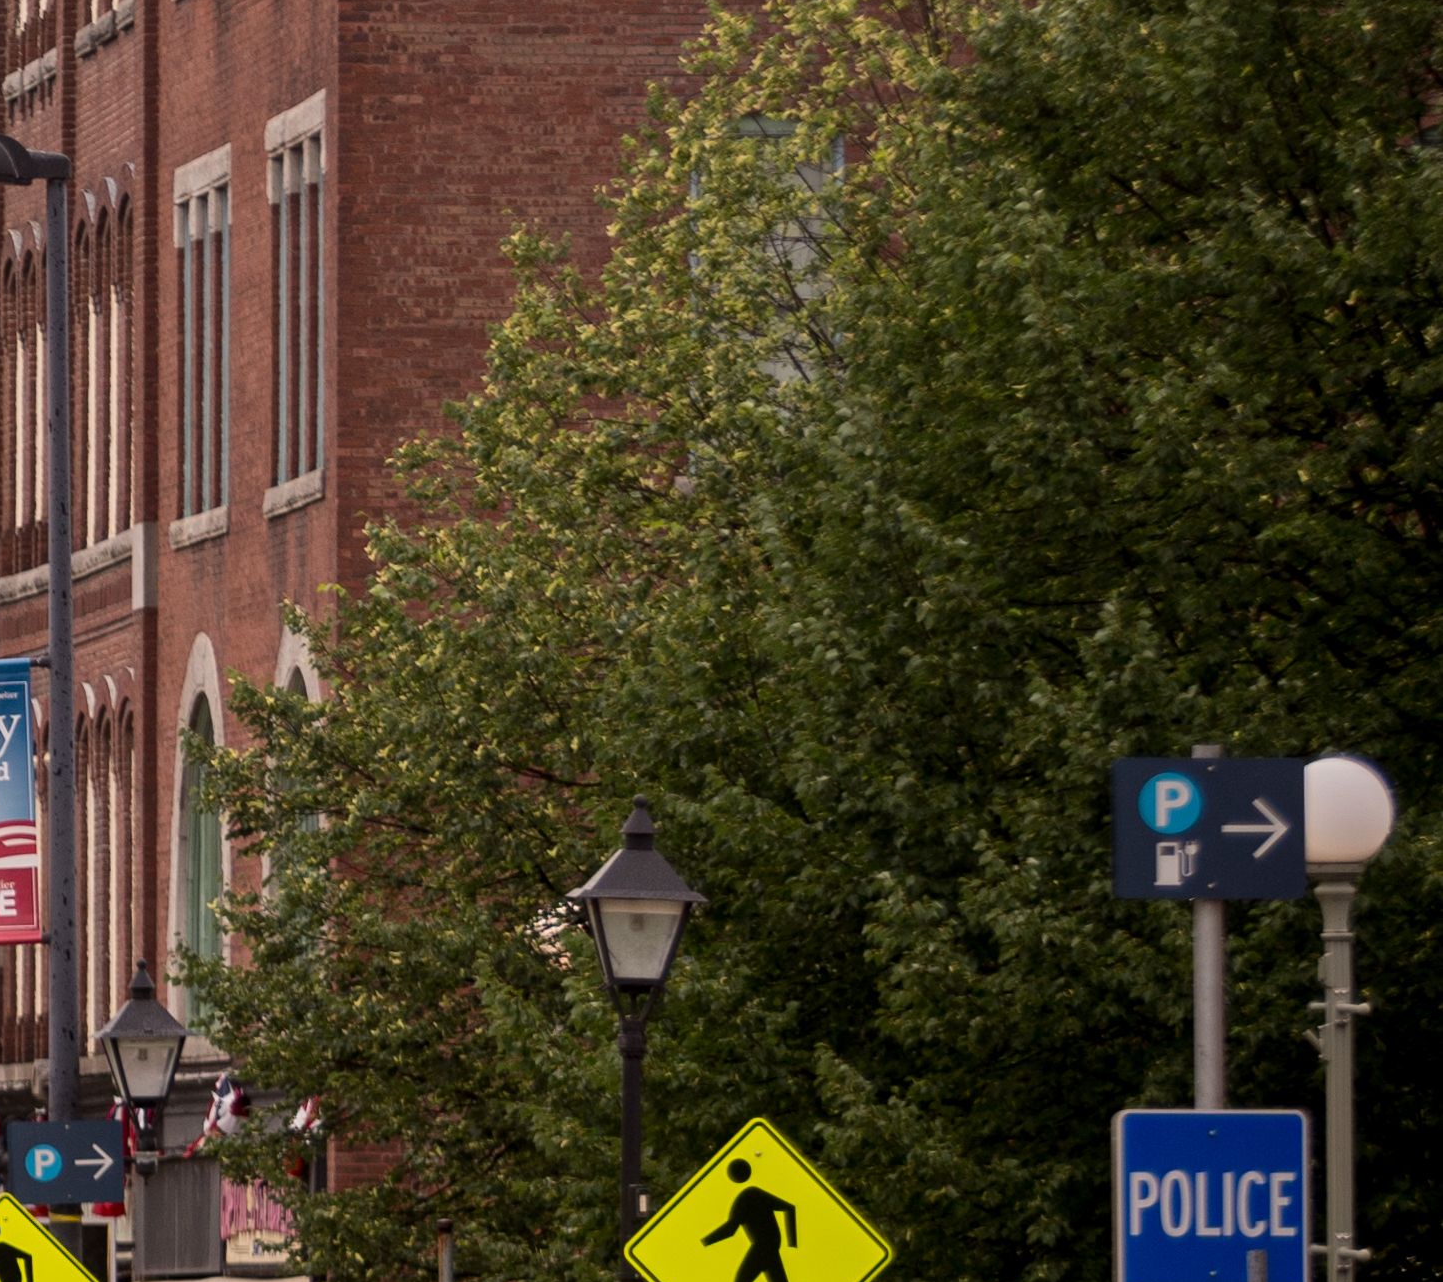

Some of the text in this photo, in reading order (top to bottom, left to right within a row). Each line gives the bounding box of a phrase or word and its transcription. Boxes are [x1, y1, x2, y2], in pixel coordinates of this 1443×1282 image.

[1154, 779, 1192, 829] P
[33, 1148, 57, 1178] P
[1129, 1169, 1299, 1239] POLICE
